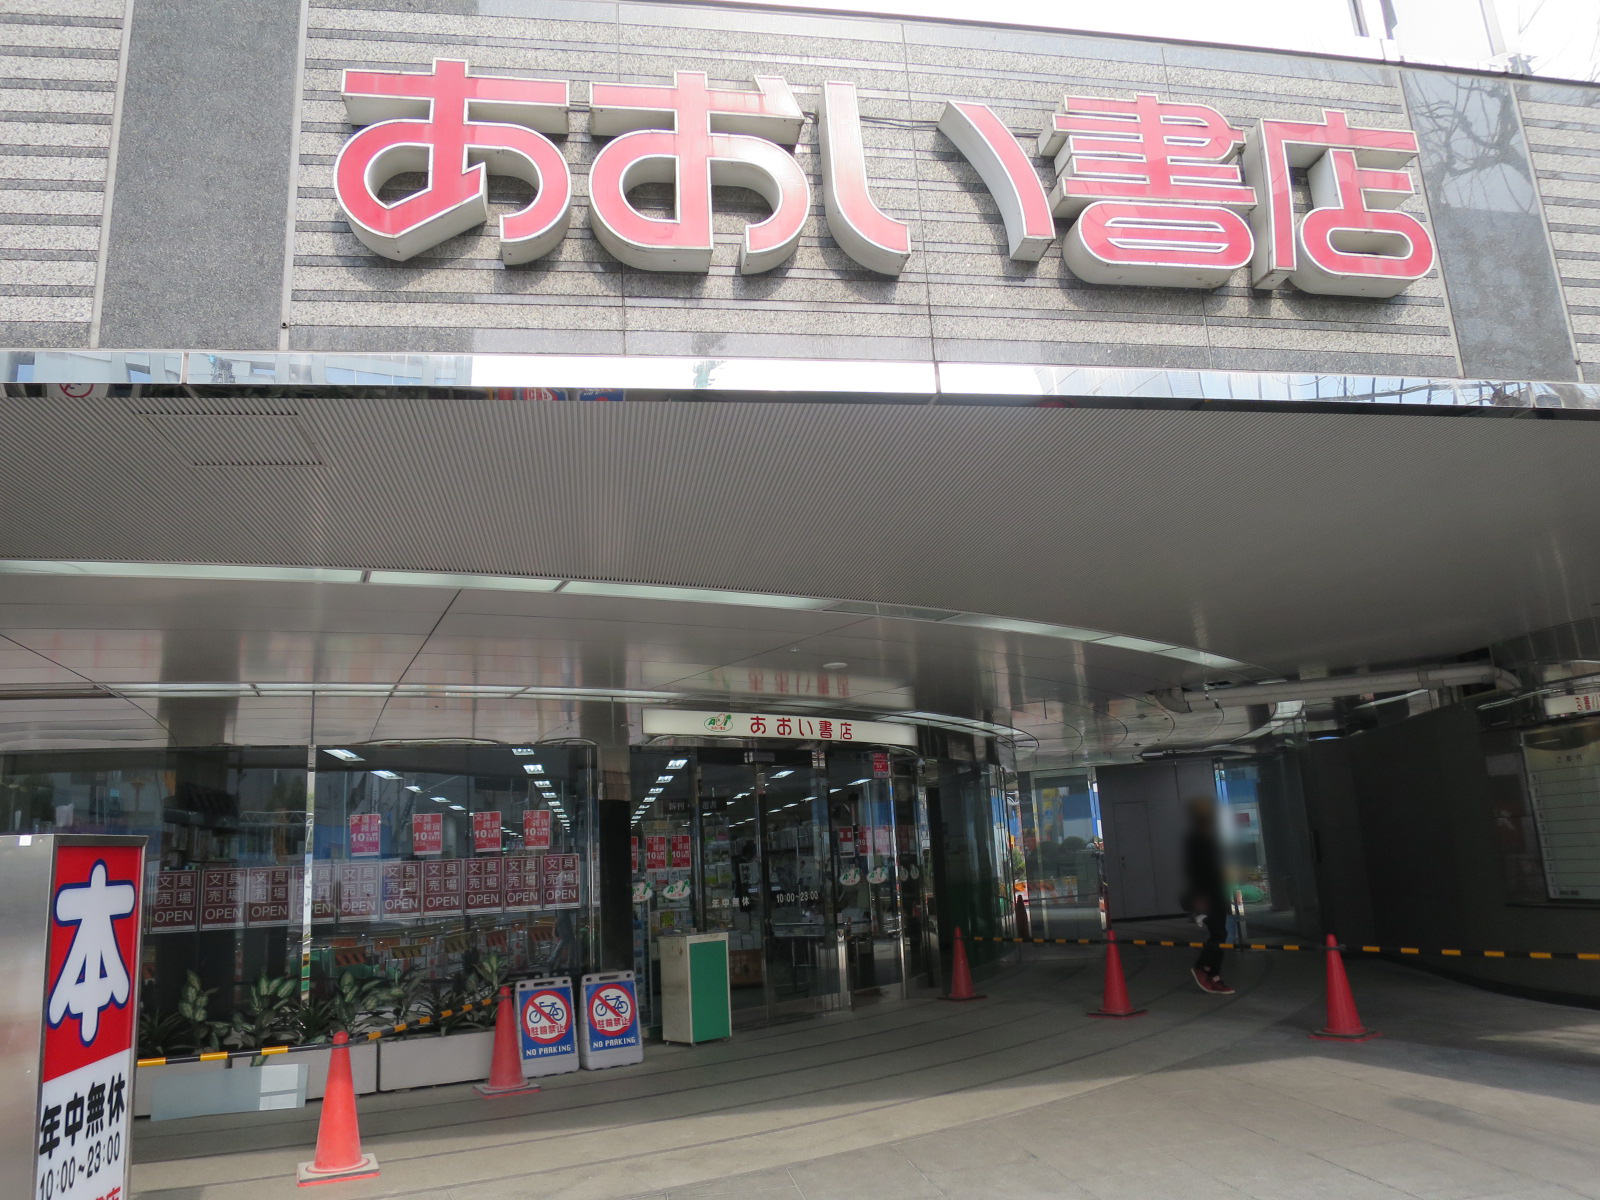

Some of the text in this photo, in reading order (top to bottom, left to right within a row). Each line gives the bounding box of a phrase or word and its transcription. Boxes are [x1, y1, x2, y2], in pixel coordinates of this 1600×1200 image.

[334, 58, 1436, 297] あおい書店
[750, 716, 853, 740] あおい書店
[428, 863, 457, 875] 文具
[469, 862, 496, 874] 文具
[508, 859, 536, 872] 文具
[547, 858, 574, 870] 文具
[343, 867, 374, 880] 文具
[387, 865, 416, 877] 文具
[159, 875, 192, 888] 文具
[209, 872, 240, 886] 文具
[467, 893, 499, 905] OPEN
[507, 891, 538, 903] OPEN
[546, 889, 576, 900] OPEN
[341, 900, 376, 913] OPEN
[384, 898, 418, 910] OPEN
[426, 896, 459, 907] OPEN
[711, 897, 750, 908] 年中無休
[155, 910, 193, 923] OPEN
[205, 907, 241, 920] OPEN
[251, 905, 288, 917] OPEN
[48, 860, 135, 1046] 本
[593, 1036, 636, 1048] NO PARKING
[526, 1044, 571, 1057] NO PARKING
[39, 1072, 125, 1160] 年中無休
